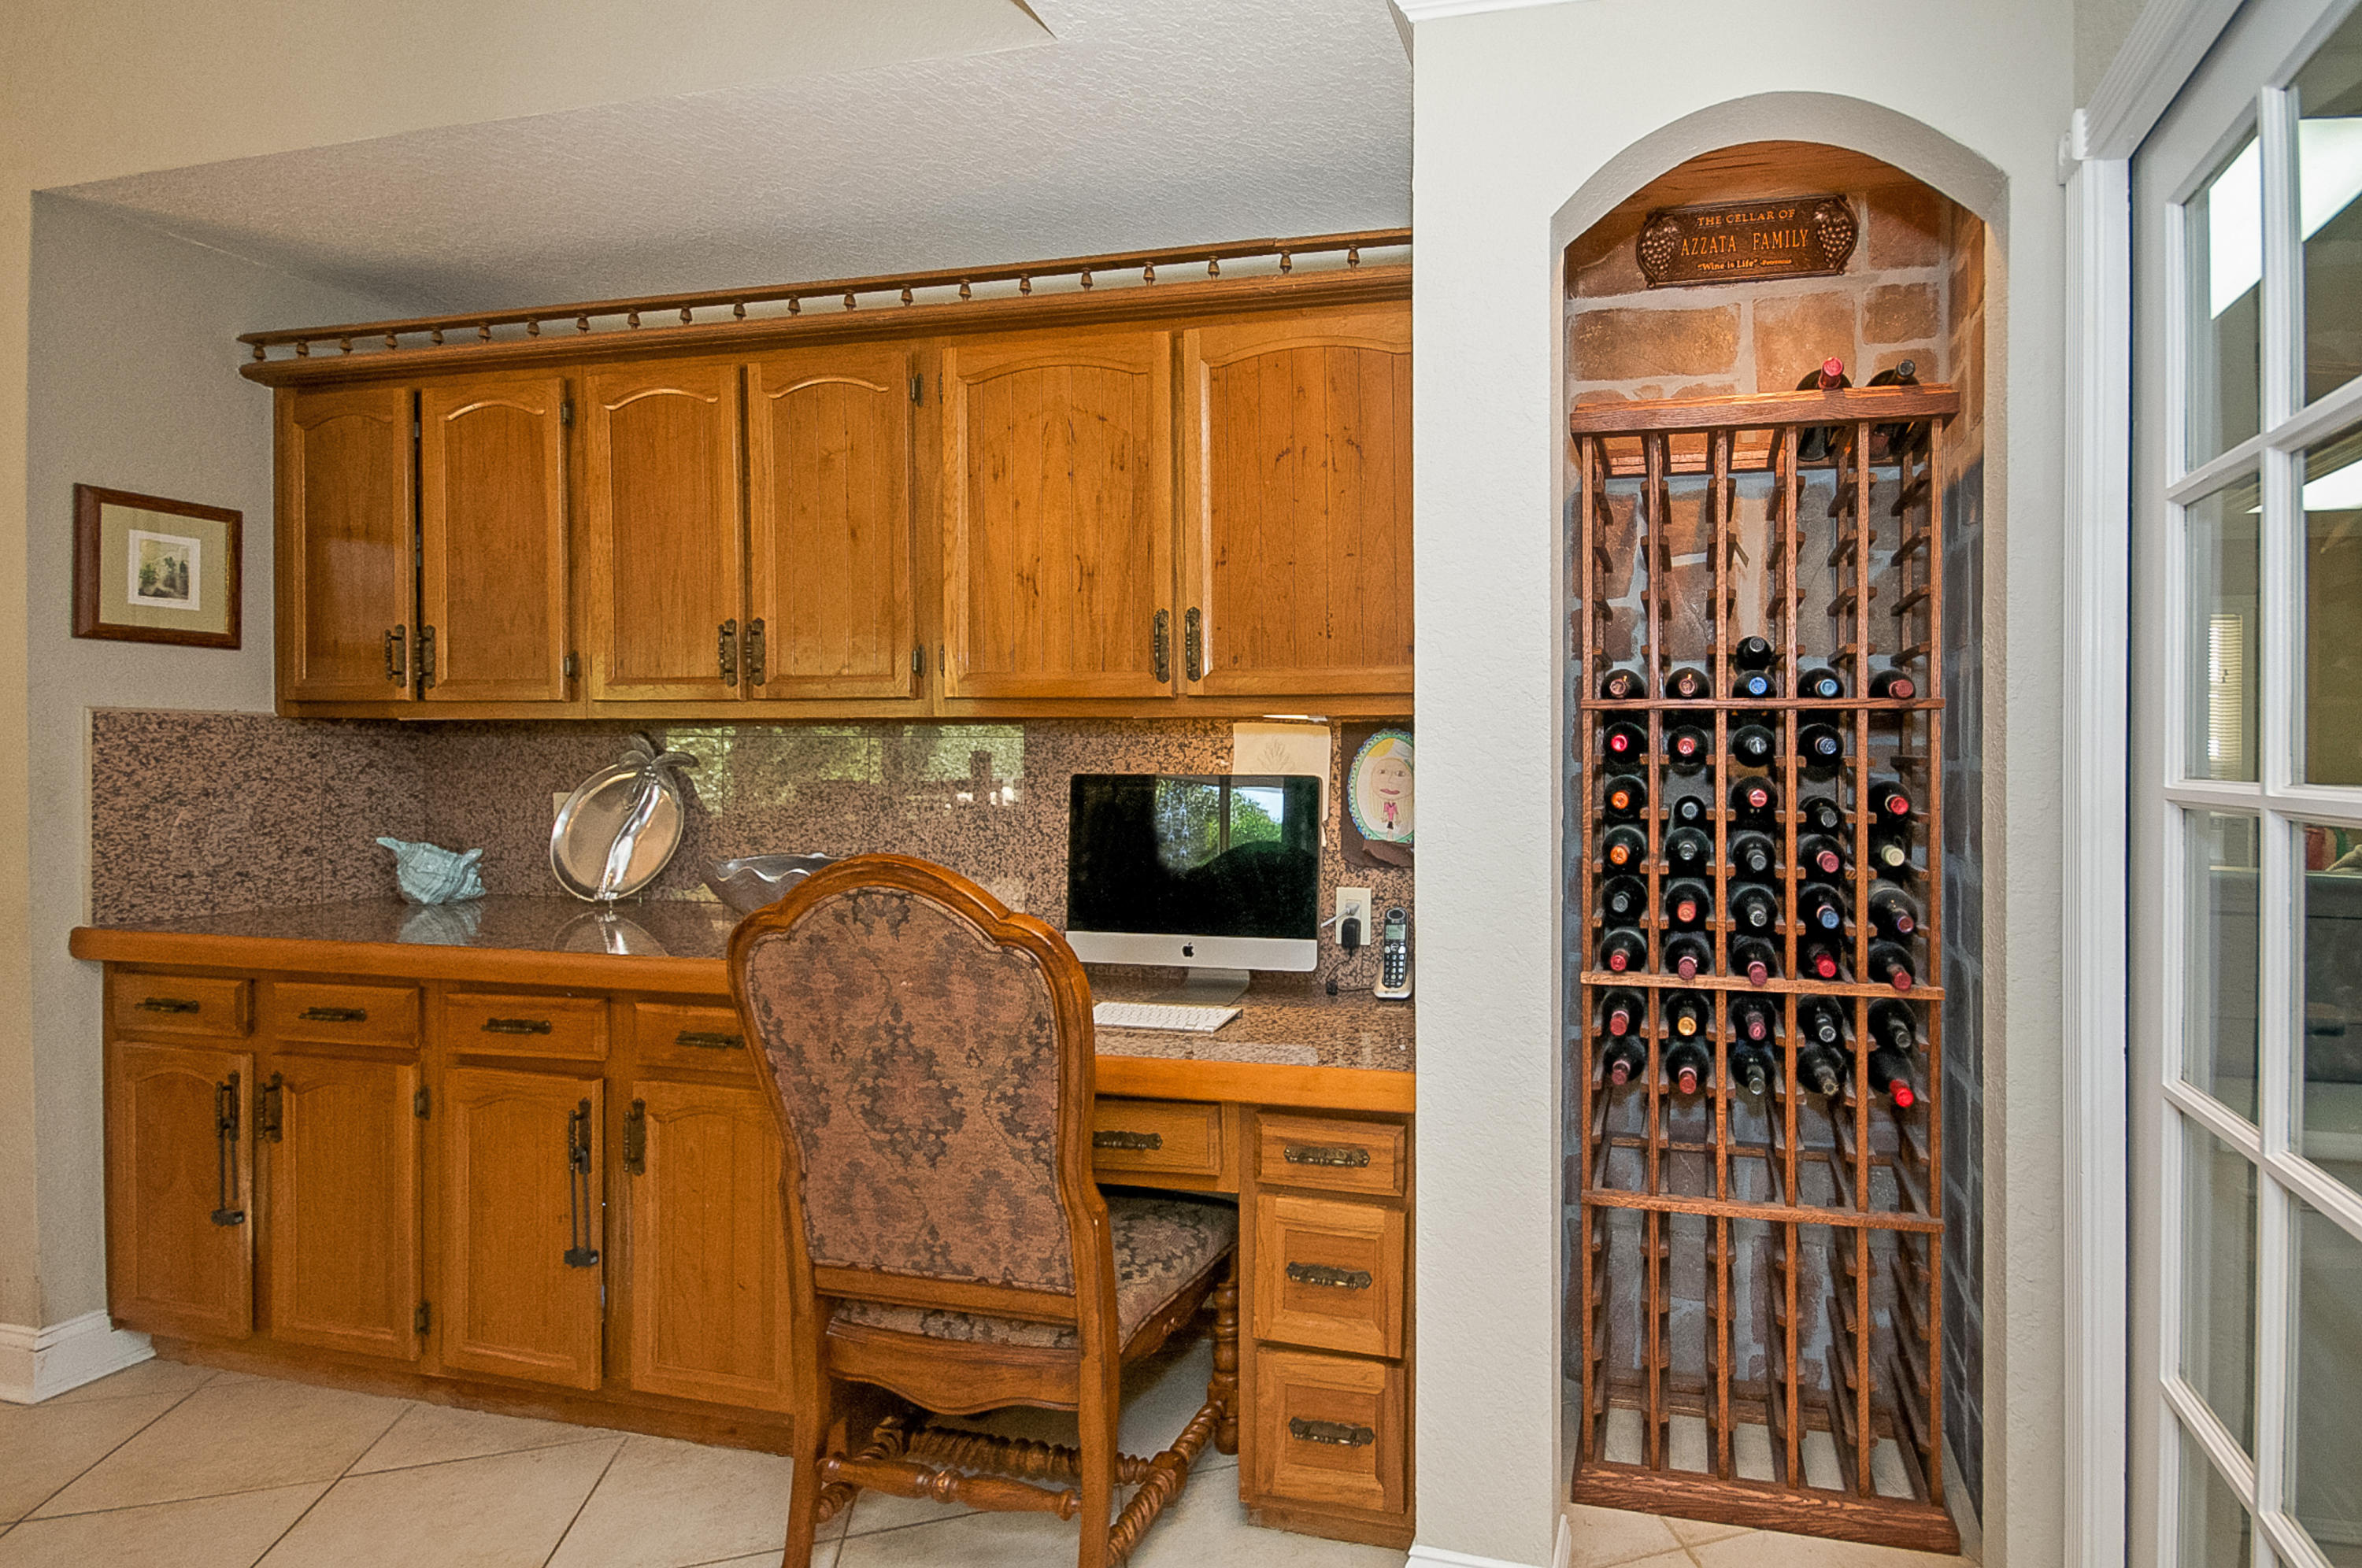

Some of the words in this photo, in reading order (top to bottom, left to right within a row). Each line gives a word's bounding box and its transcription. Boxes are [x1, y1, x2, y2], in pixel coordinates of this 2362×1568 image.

[1697, 216, 1722, 226] THE
[1726, 211, 1775, 224] CELLAR
[1779, 209, 1796, 219] OF
[1681, 235, 1737, 256] AZZATA
[1753, 228, 1809, 250] FAMILY
